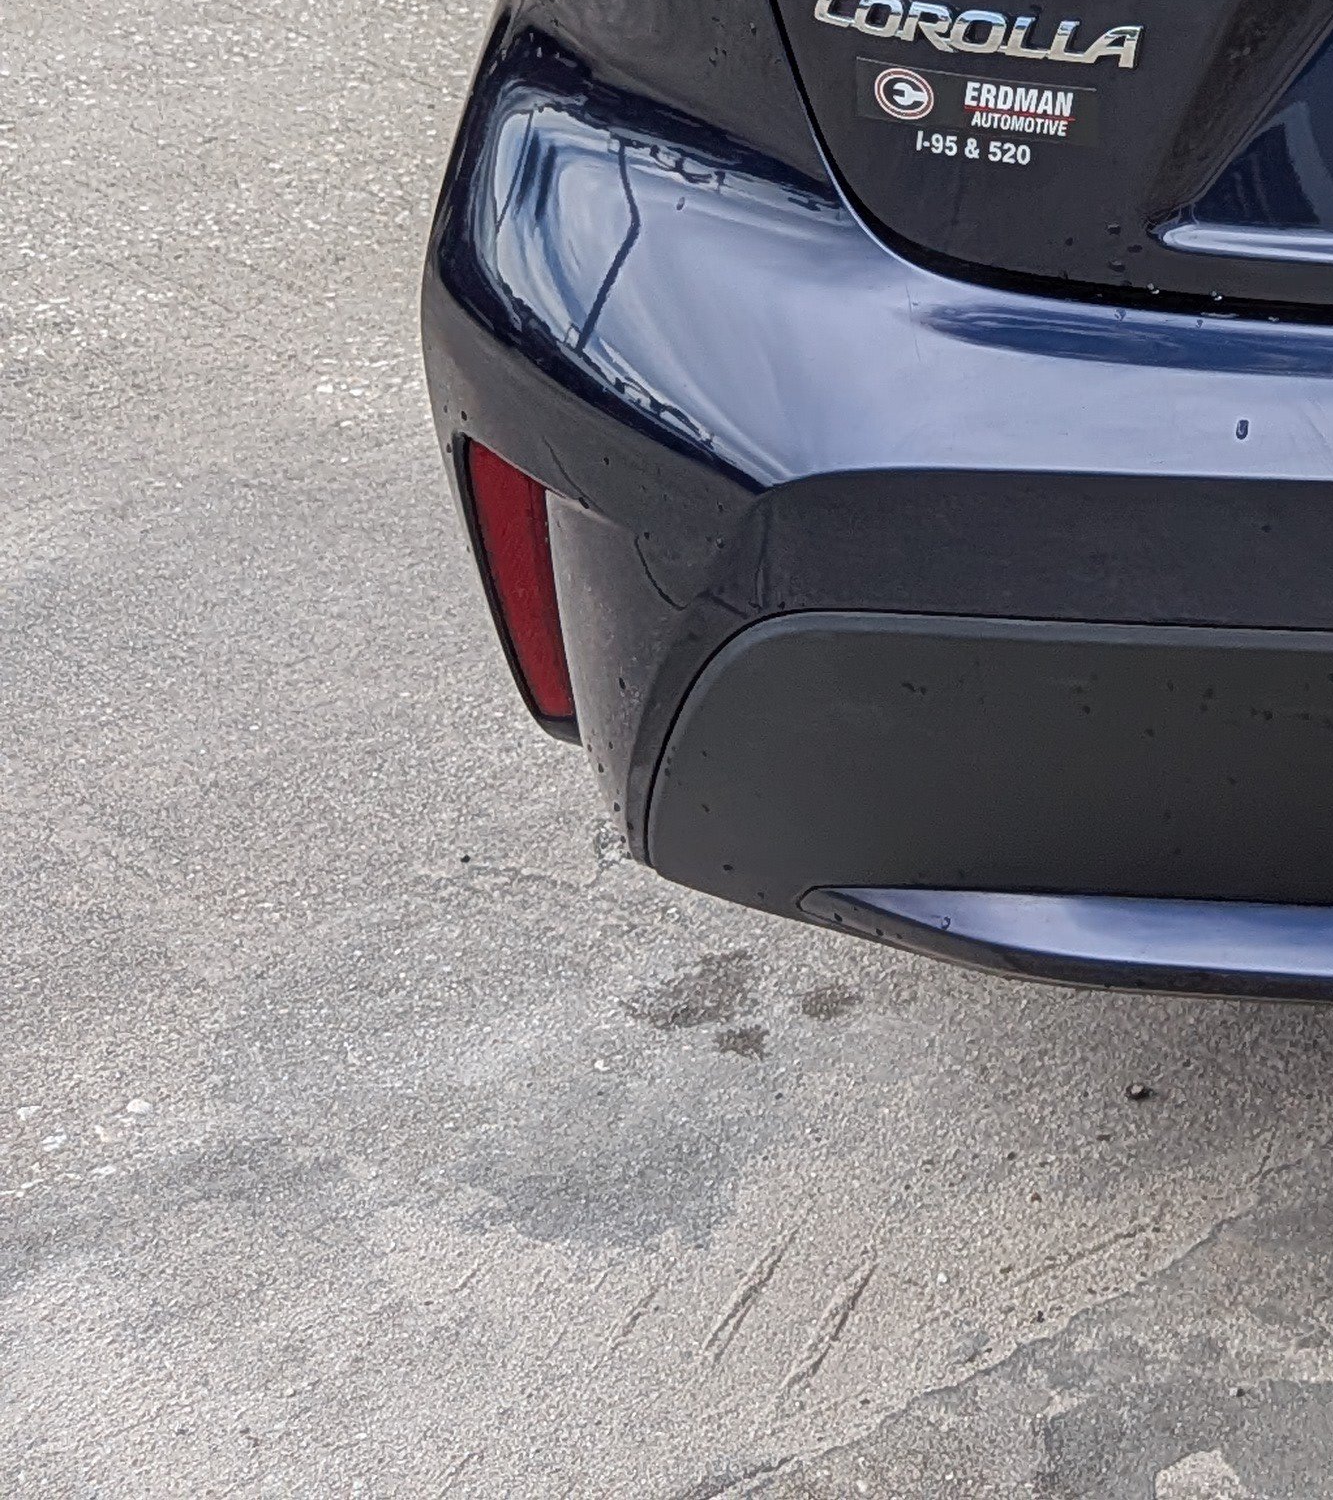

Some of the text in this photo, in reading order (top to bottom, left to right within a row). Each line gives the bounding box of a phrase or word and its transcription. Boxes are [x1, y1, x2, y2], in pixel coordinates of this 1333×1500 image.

[964, 81, 1074, 117] ERDMAN
[971, 111, 1069, 137] AUTOMOTIVE
[916, 130, 1031, 165] I-95 & 520
